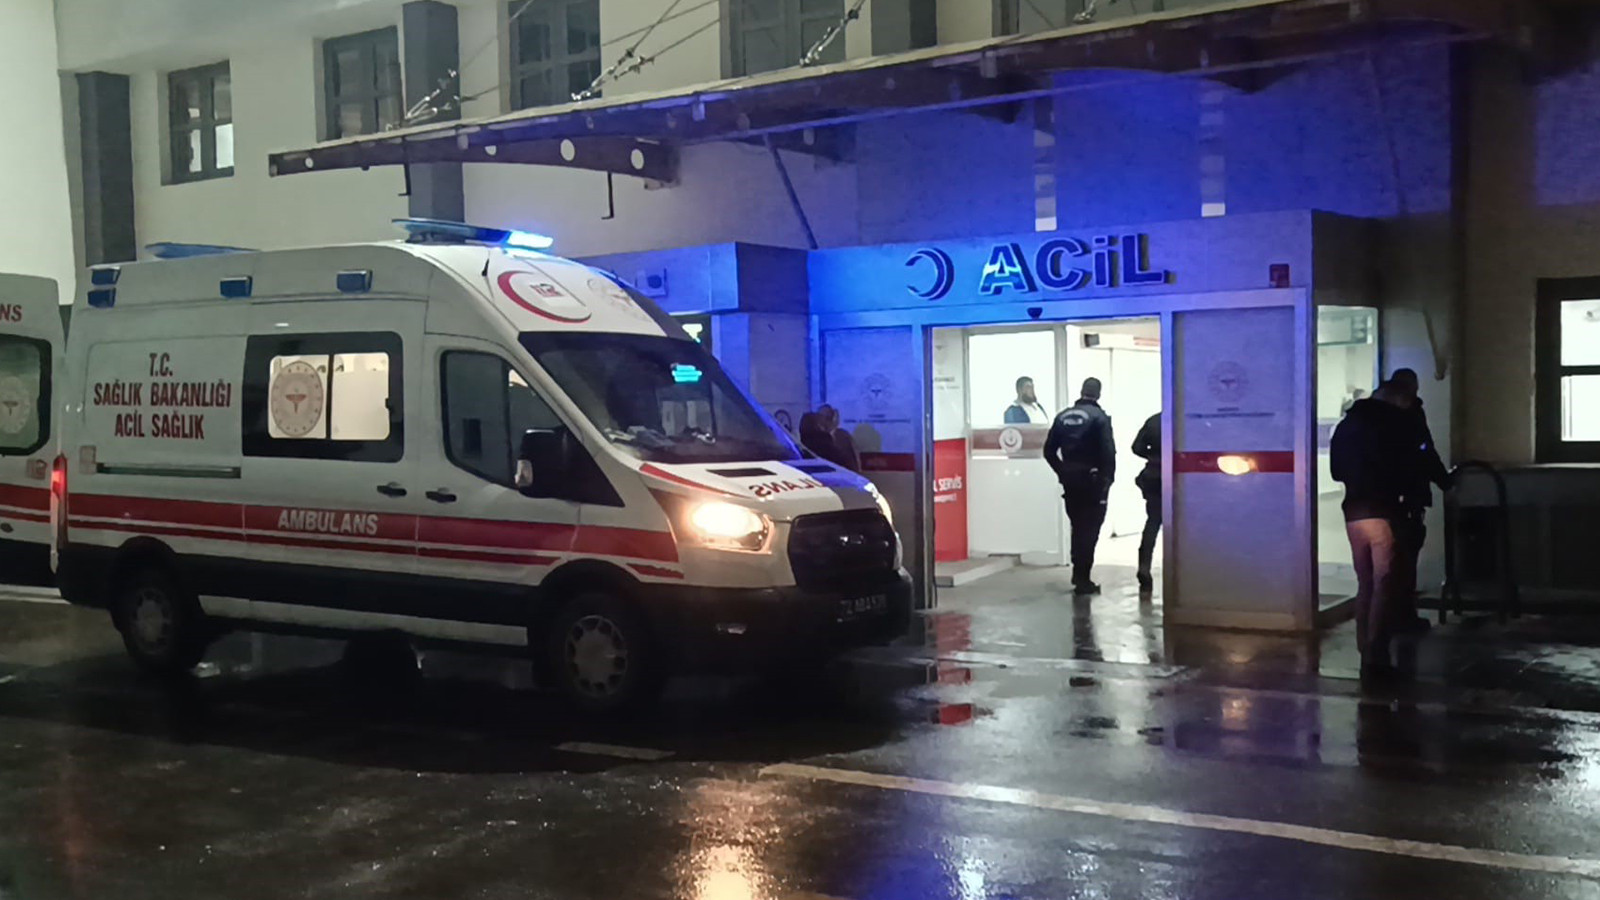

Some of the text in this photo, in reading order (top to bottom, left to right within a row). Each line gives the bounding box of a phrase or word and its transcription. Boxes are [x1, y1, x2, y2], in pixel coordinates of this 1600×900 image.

[149, 353, 173, 376] T.C.
[93, 379, 231, 407] SAĞLIK BAKANLIĞI
[115, 409, 204, 439] ACİL SAĞLIK
[278, 510, 378, 535] AMBULANS
